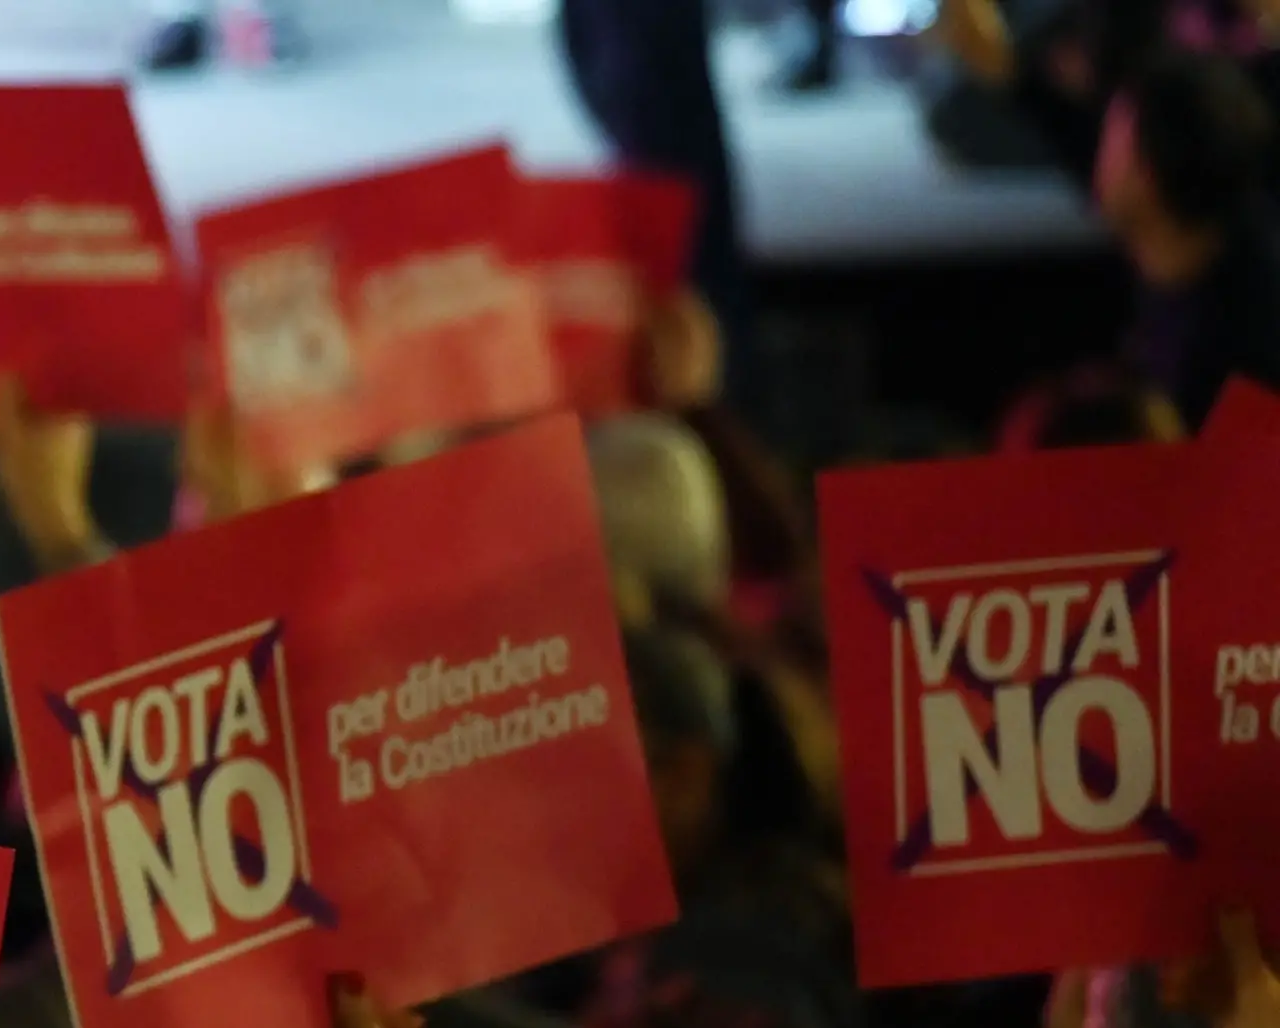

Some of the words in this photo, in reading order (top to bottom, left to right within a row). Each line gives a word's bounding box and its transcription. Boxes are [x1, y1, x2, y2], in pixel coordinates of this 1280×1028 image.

[329, 691, 389, 756] per
[395, 636, 570, 722] difendere
[906, 579, 1139, 685] VOTA
[79, 657, 268, 798] VOTA
[339, 749, 374, 803] la
[381, 686, 607, 789] Costituzione
[920, 674, 1156, 847] NO
[102, 757, 296, 963] NO
